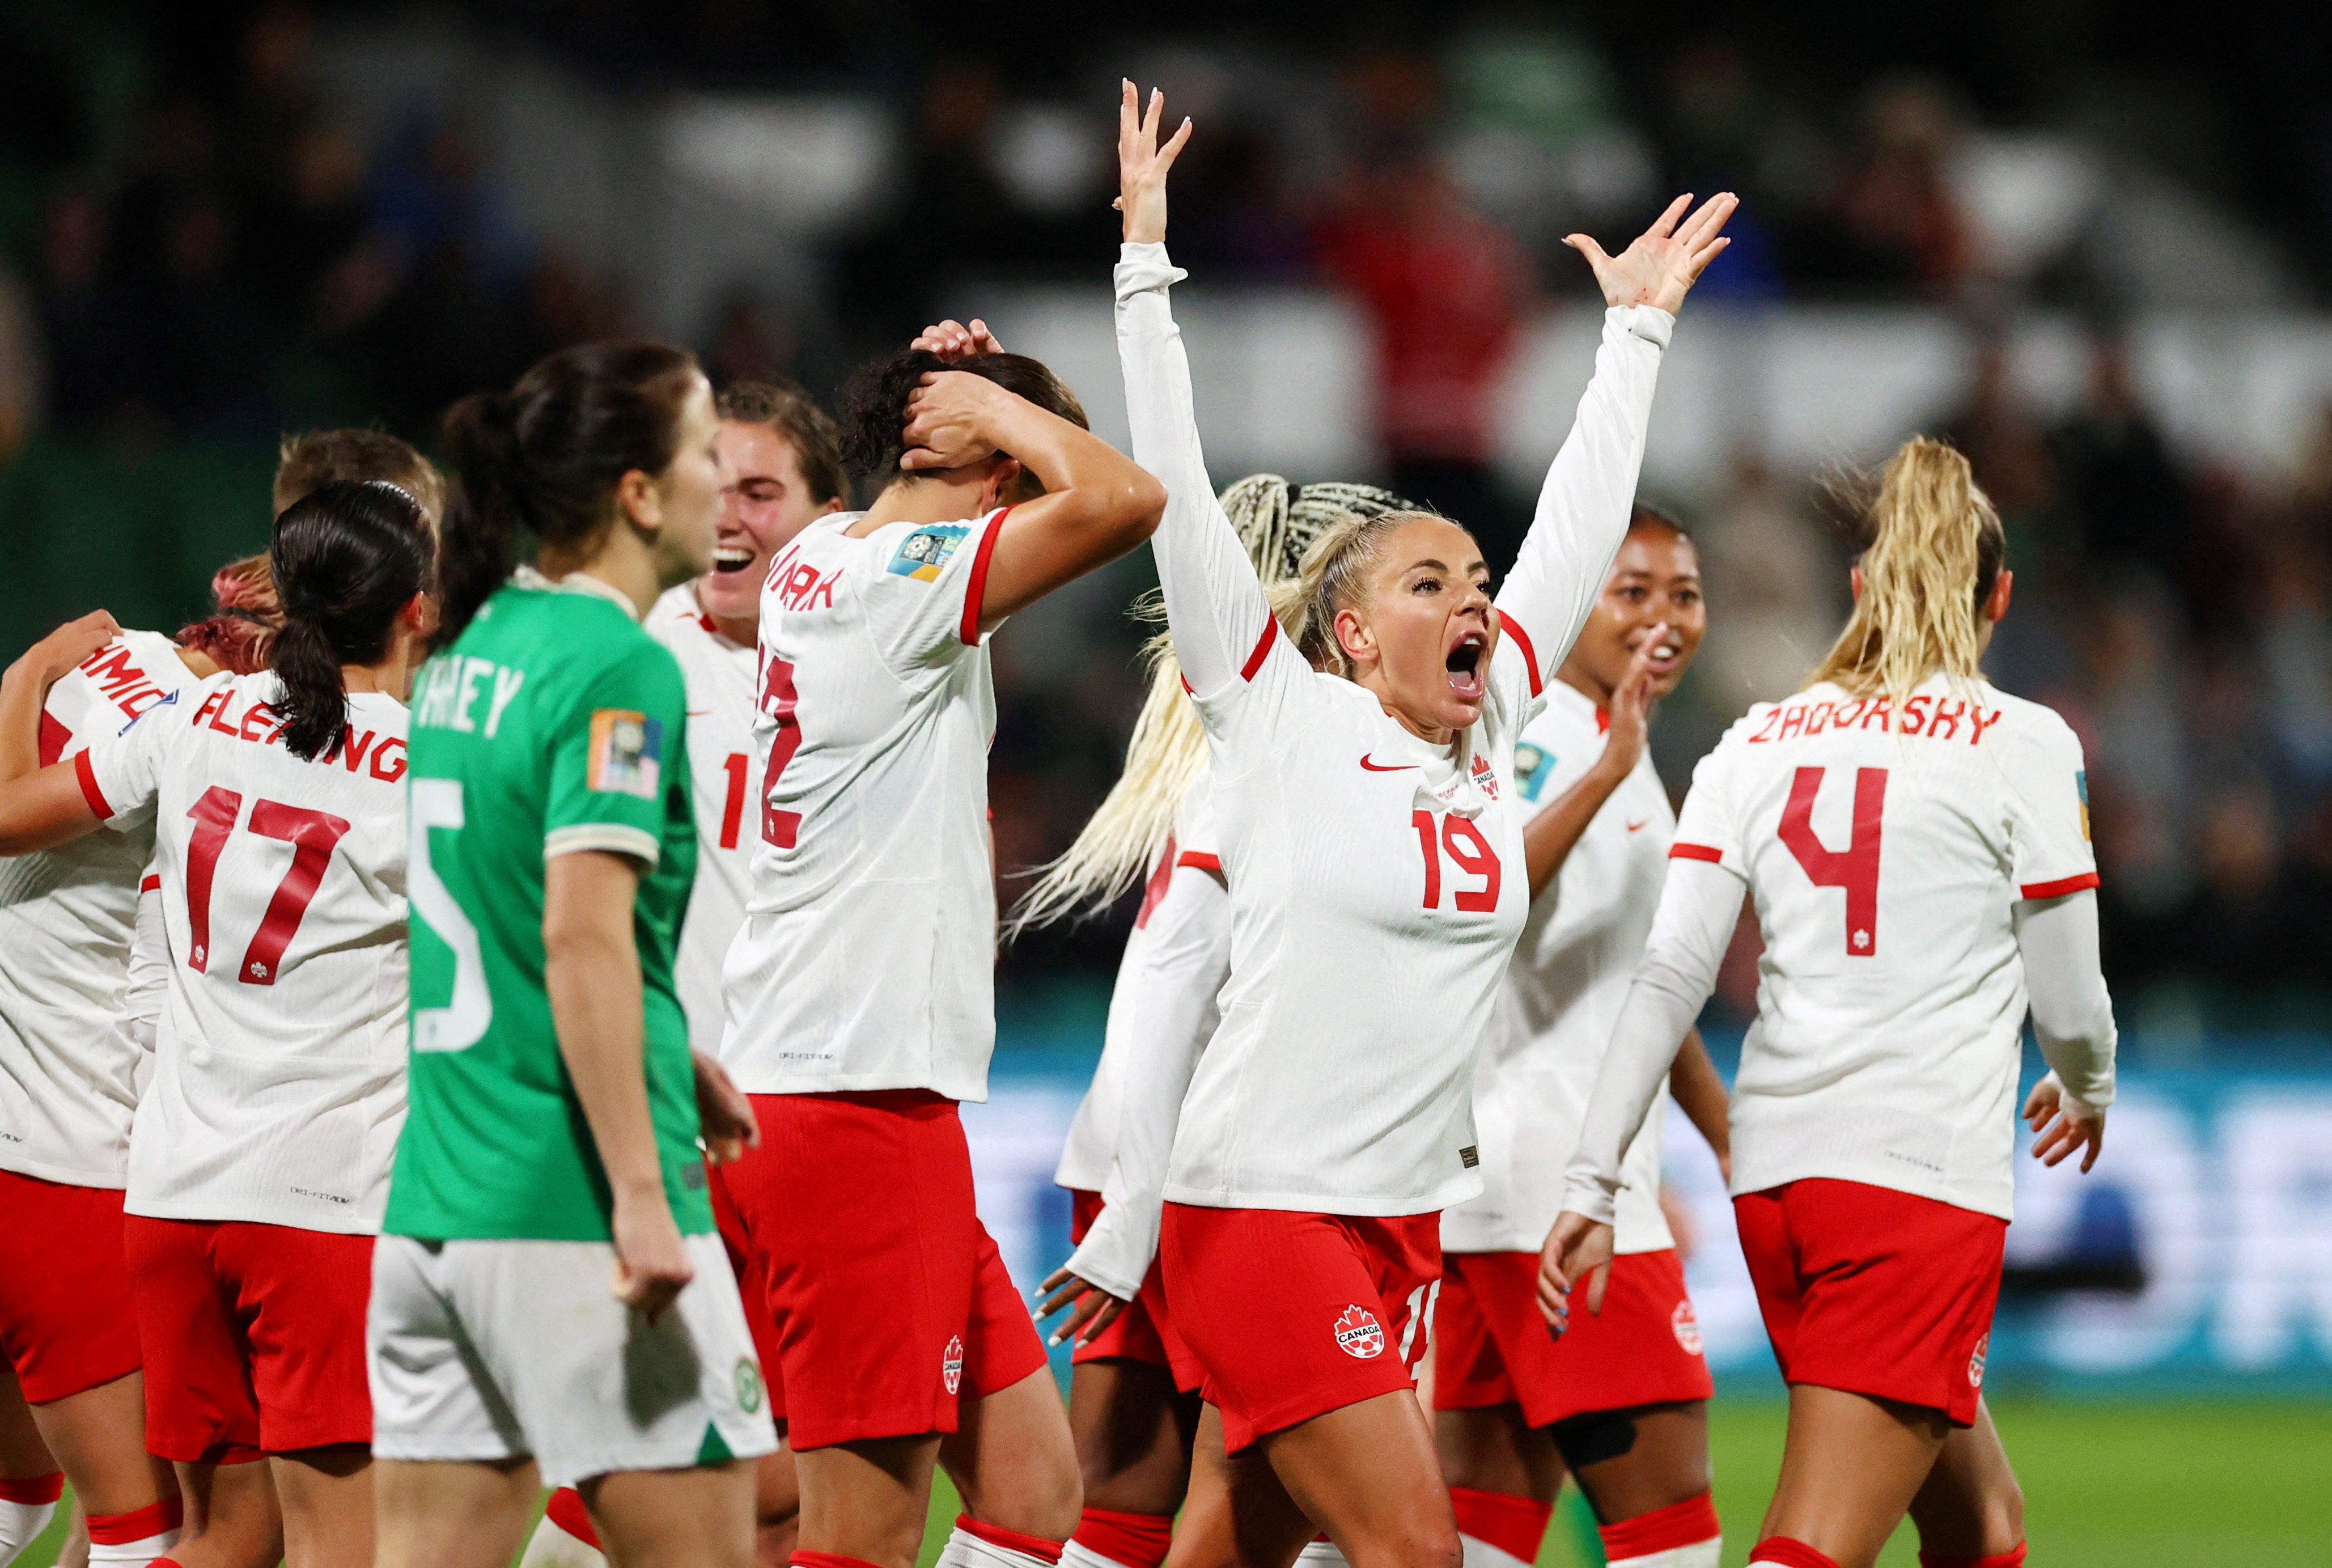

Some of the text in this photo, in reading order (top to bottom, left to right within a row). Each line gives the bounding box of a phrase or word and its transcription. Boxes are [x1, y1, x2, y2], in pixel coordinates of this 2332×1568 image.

[193, 689, 407, 783] FLENG
[186, 785, 351, 985] 17
[408, 777, 493, 1052] 5
[1411, 810, 1501, 913] 19
[1778, 766, 1888, 956] 4
[1338, 1326, 1381, 1343] CANADA
